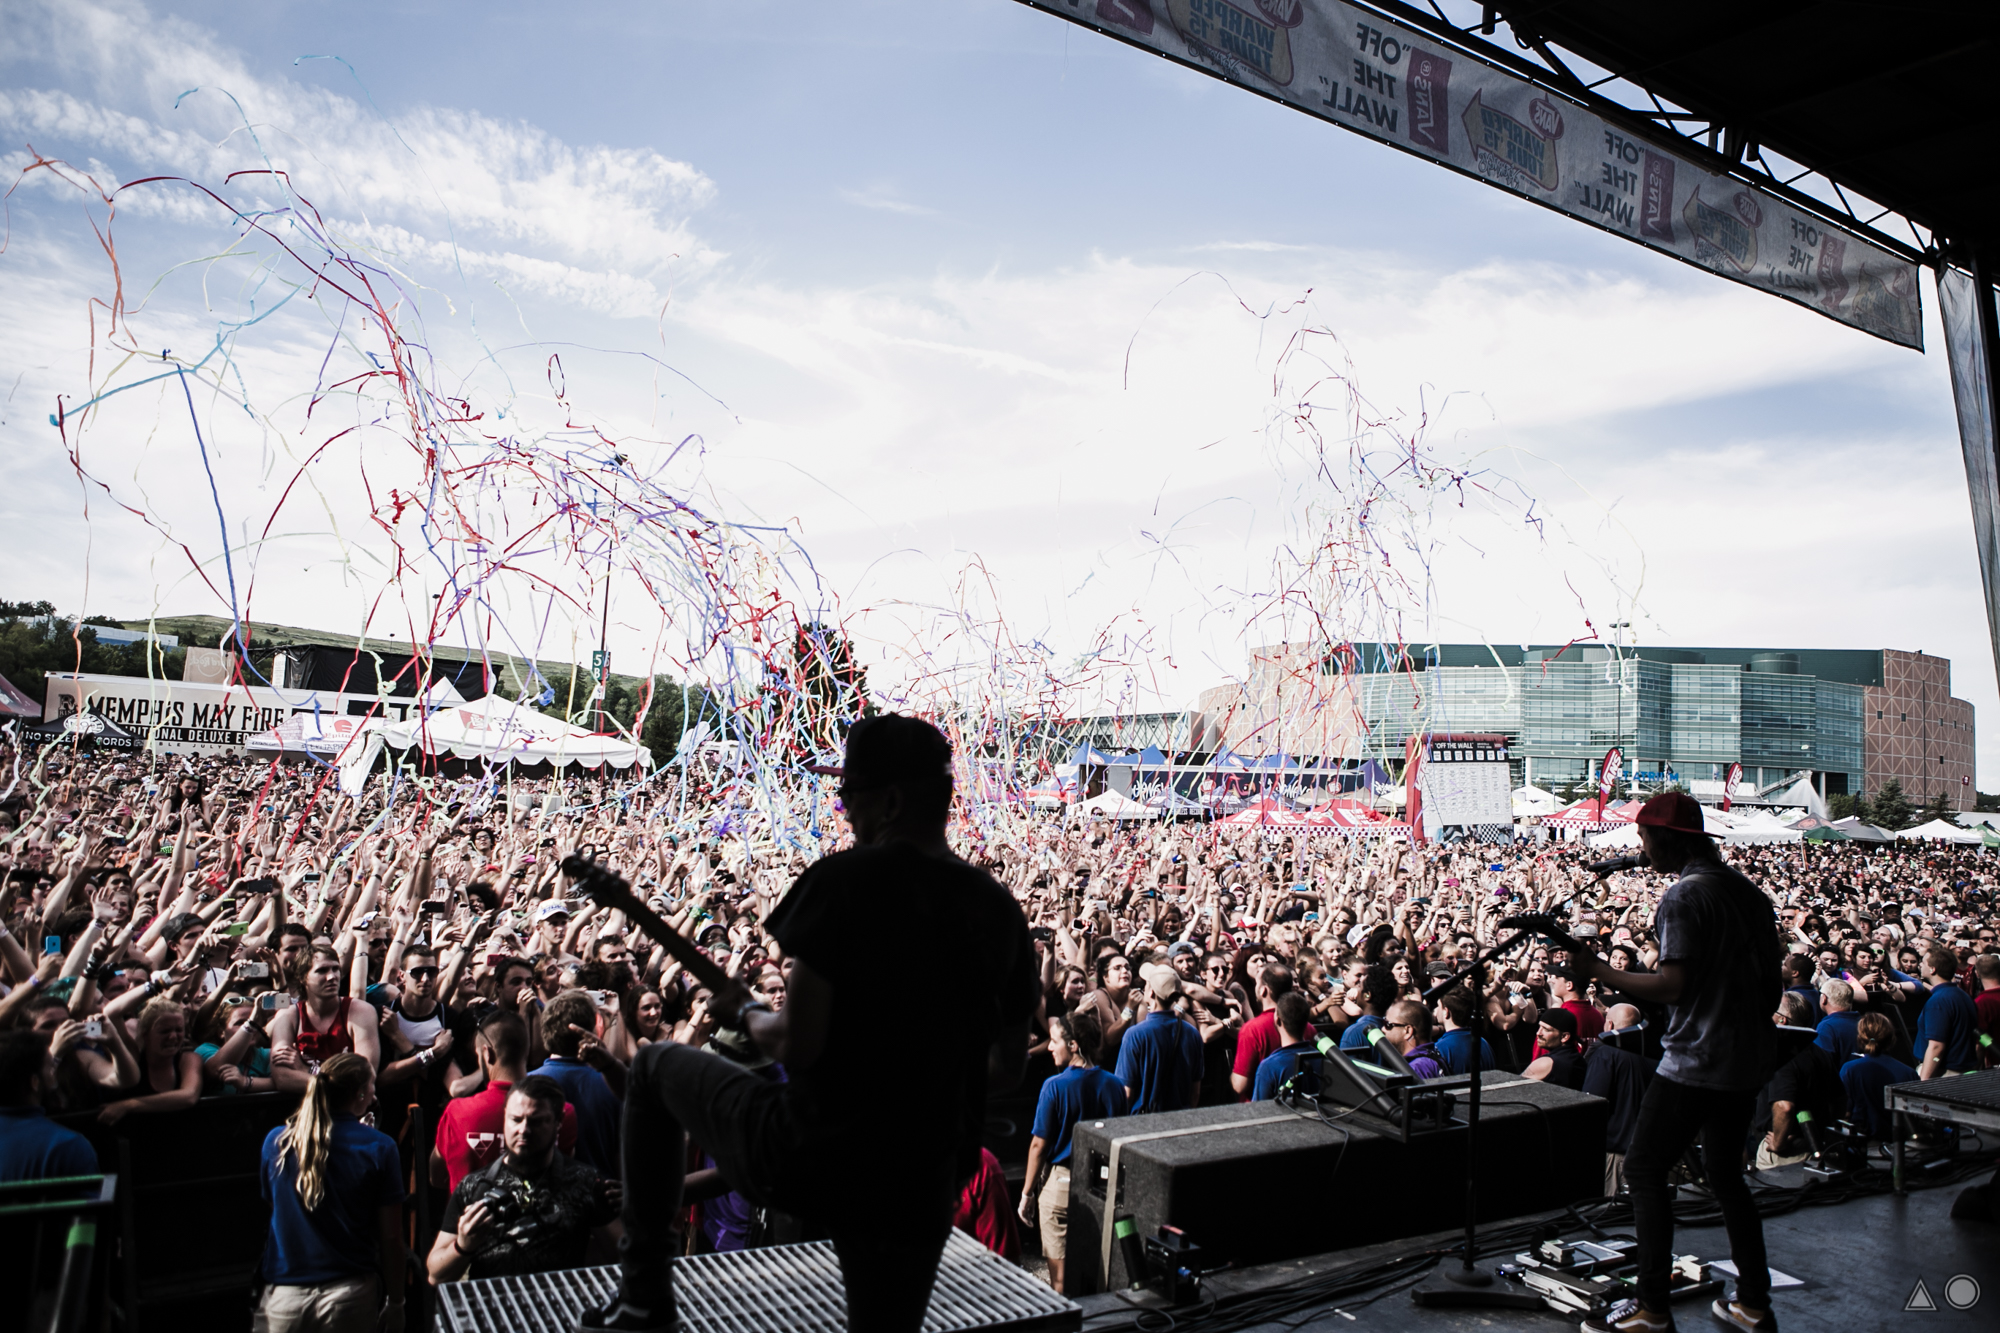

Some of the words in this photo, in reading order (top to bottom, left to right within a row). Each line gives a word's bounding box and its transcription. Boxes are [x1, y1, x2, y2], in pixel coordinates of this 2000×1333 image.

[191, 702, 237, 730] MAY
[188, 730, 231, 744] DELUXE
[1724, 764, 1743, 801] VANS
